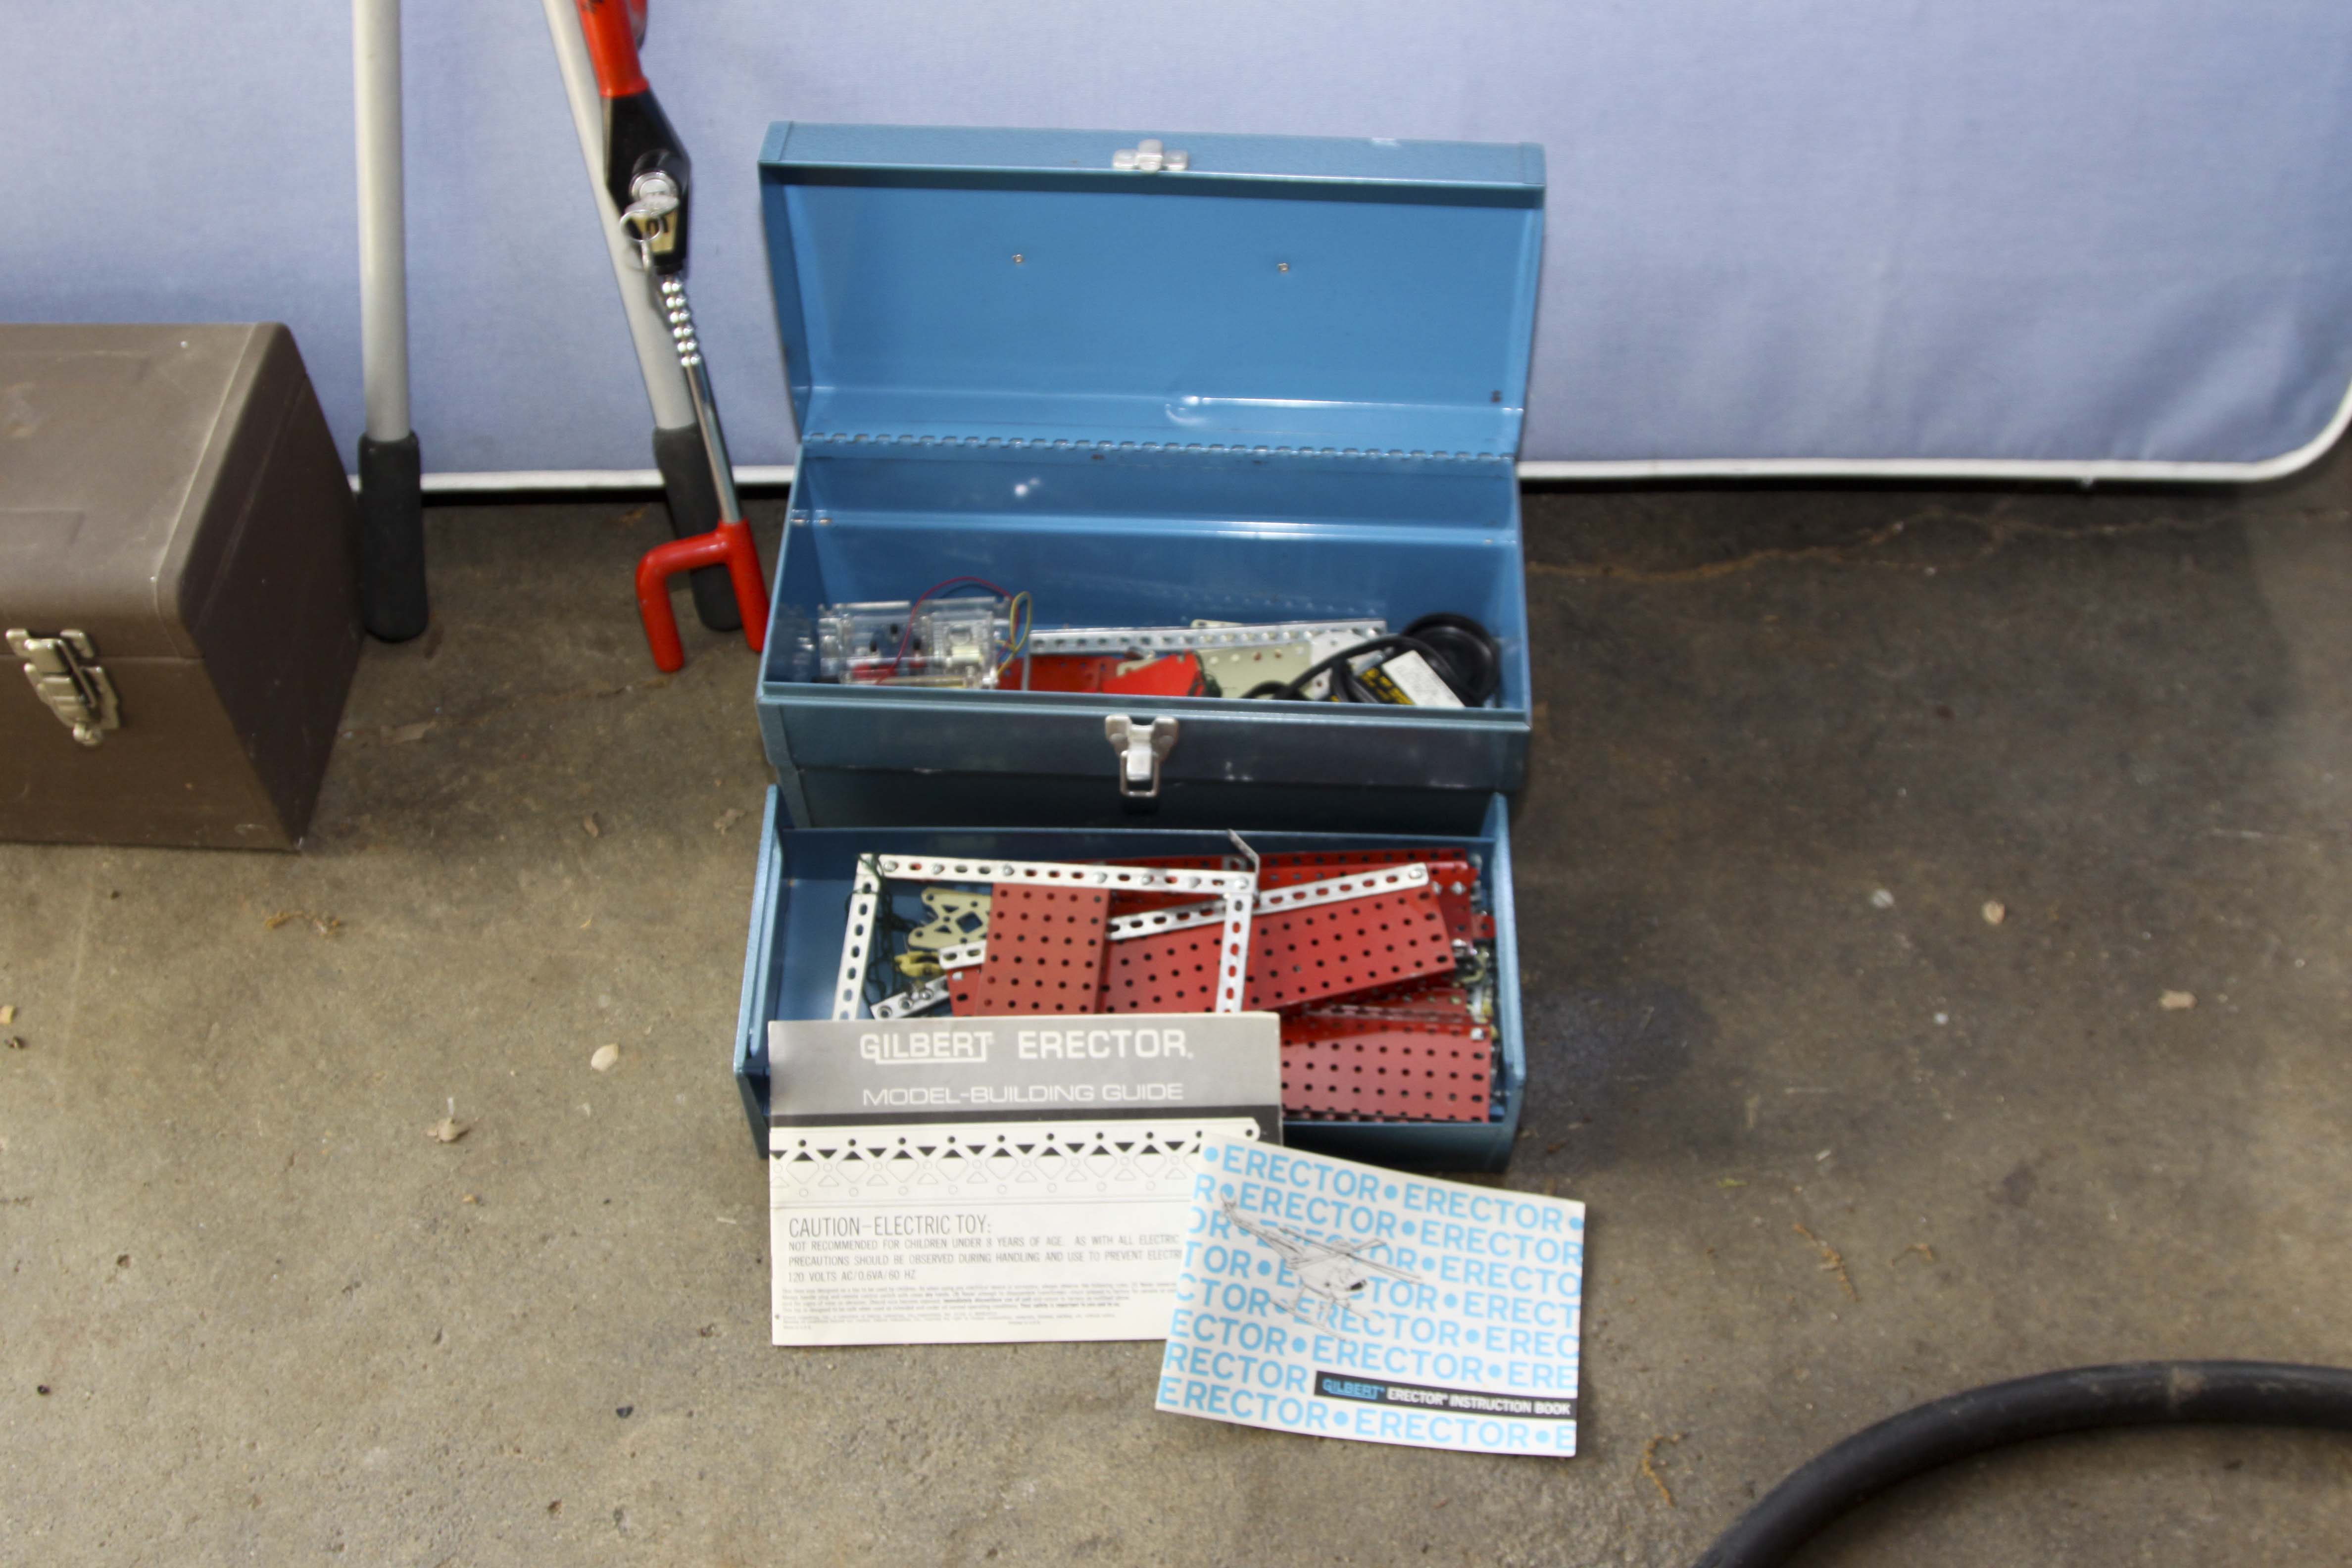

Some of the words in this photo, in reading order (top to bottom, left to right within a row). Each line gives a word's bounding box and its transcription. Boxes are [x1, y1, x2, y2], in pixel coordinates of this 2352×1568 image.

[863, 1084, 1094, 1105] MODEL-BUILDING
[1102, 1083, 1183, 1101] GUIDE
[1222, 1144, 1379, 1202] ERECTOR
[1404, 1182, 1563, 1233] ERECTOR
[788, 1241, 806, 1252] NOT
[811, 1240, 878, 1251] RECOMMENDED
[883, 1239, 900, 1250] FOR
[904, 1238, 947, 1249] CHILDREN
[952, 1237, 982, 1248] UNDER
[997, 1236, 1025, 1247] YEARS
[1029, 1236, 1040, 1247] OF
[1075, 1235, 1086, 1246] AS
[1091, 1235, 1113, 1246] WITH
[1119, 1235, 1133, 1246] ALL
[956, 1214, 991, 1235] TOY:
[1193, 1174, 1216, 1203] R
[1238, 1181, 1397, 1239] ERECTOR
[1421, 1219, 1583, 1268] ERECTOR
[788, 1255, 849, 1267] PRECAUTIONS
[854, 1255, 888, 1266] SHOULD
[893, 1254, 904, 1265] BE
[909, 1253, 954, 1265] OBSERVED
[959, 1252, 991, 1264] DURING
[996, 1252, 1040, 1263] HANDLING
[1045, 1251, 1063, 1262] AND
[1068, 1251, 1084, 1262] USE
[1088, 1250, 1100, 1262] TO
[1105, 1250, 1142, 1261] PREVENT
[809, 1271, 836, 1281] VOLTS
[1440, 1255, 1581, 1297] ERECTO
[1185, 1241, 1251, 1279] TOR
[1464, 1290, 1580, 1328] ERECT
[1176, 1273, 1270, 1317] CTOR
[1485, 1325, 1579, 1359] EREC
[1164, 1342, 1308, 1395] RECTOR
[1170, 1309, 1287, 1356] ECTOR
[1312, 1334, 1483, 1383] ERECTOR
[1508, 1361, 1577, 1390] ERE
[1158, 1376, 1329, 1429] ERECTOR
[1355, 1407, 1529, 1449] ERECTOR
[1449, 1394, 1531, 1413] INSTRUCTION
[1534, 1401, 1571, 1415] BOOK
